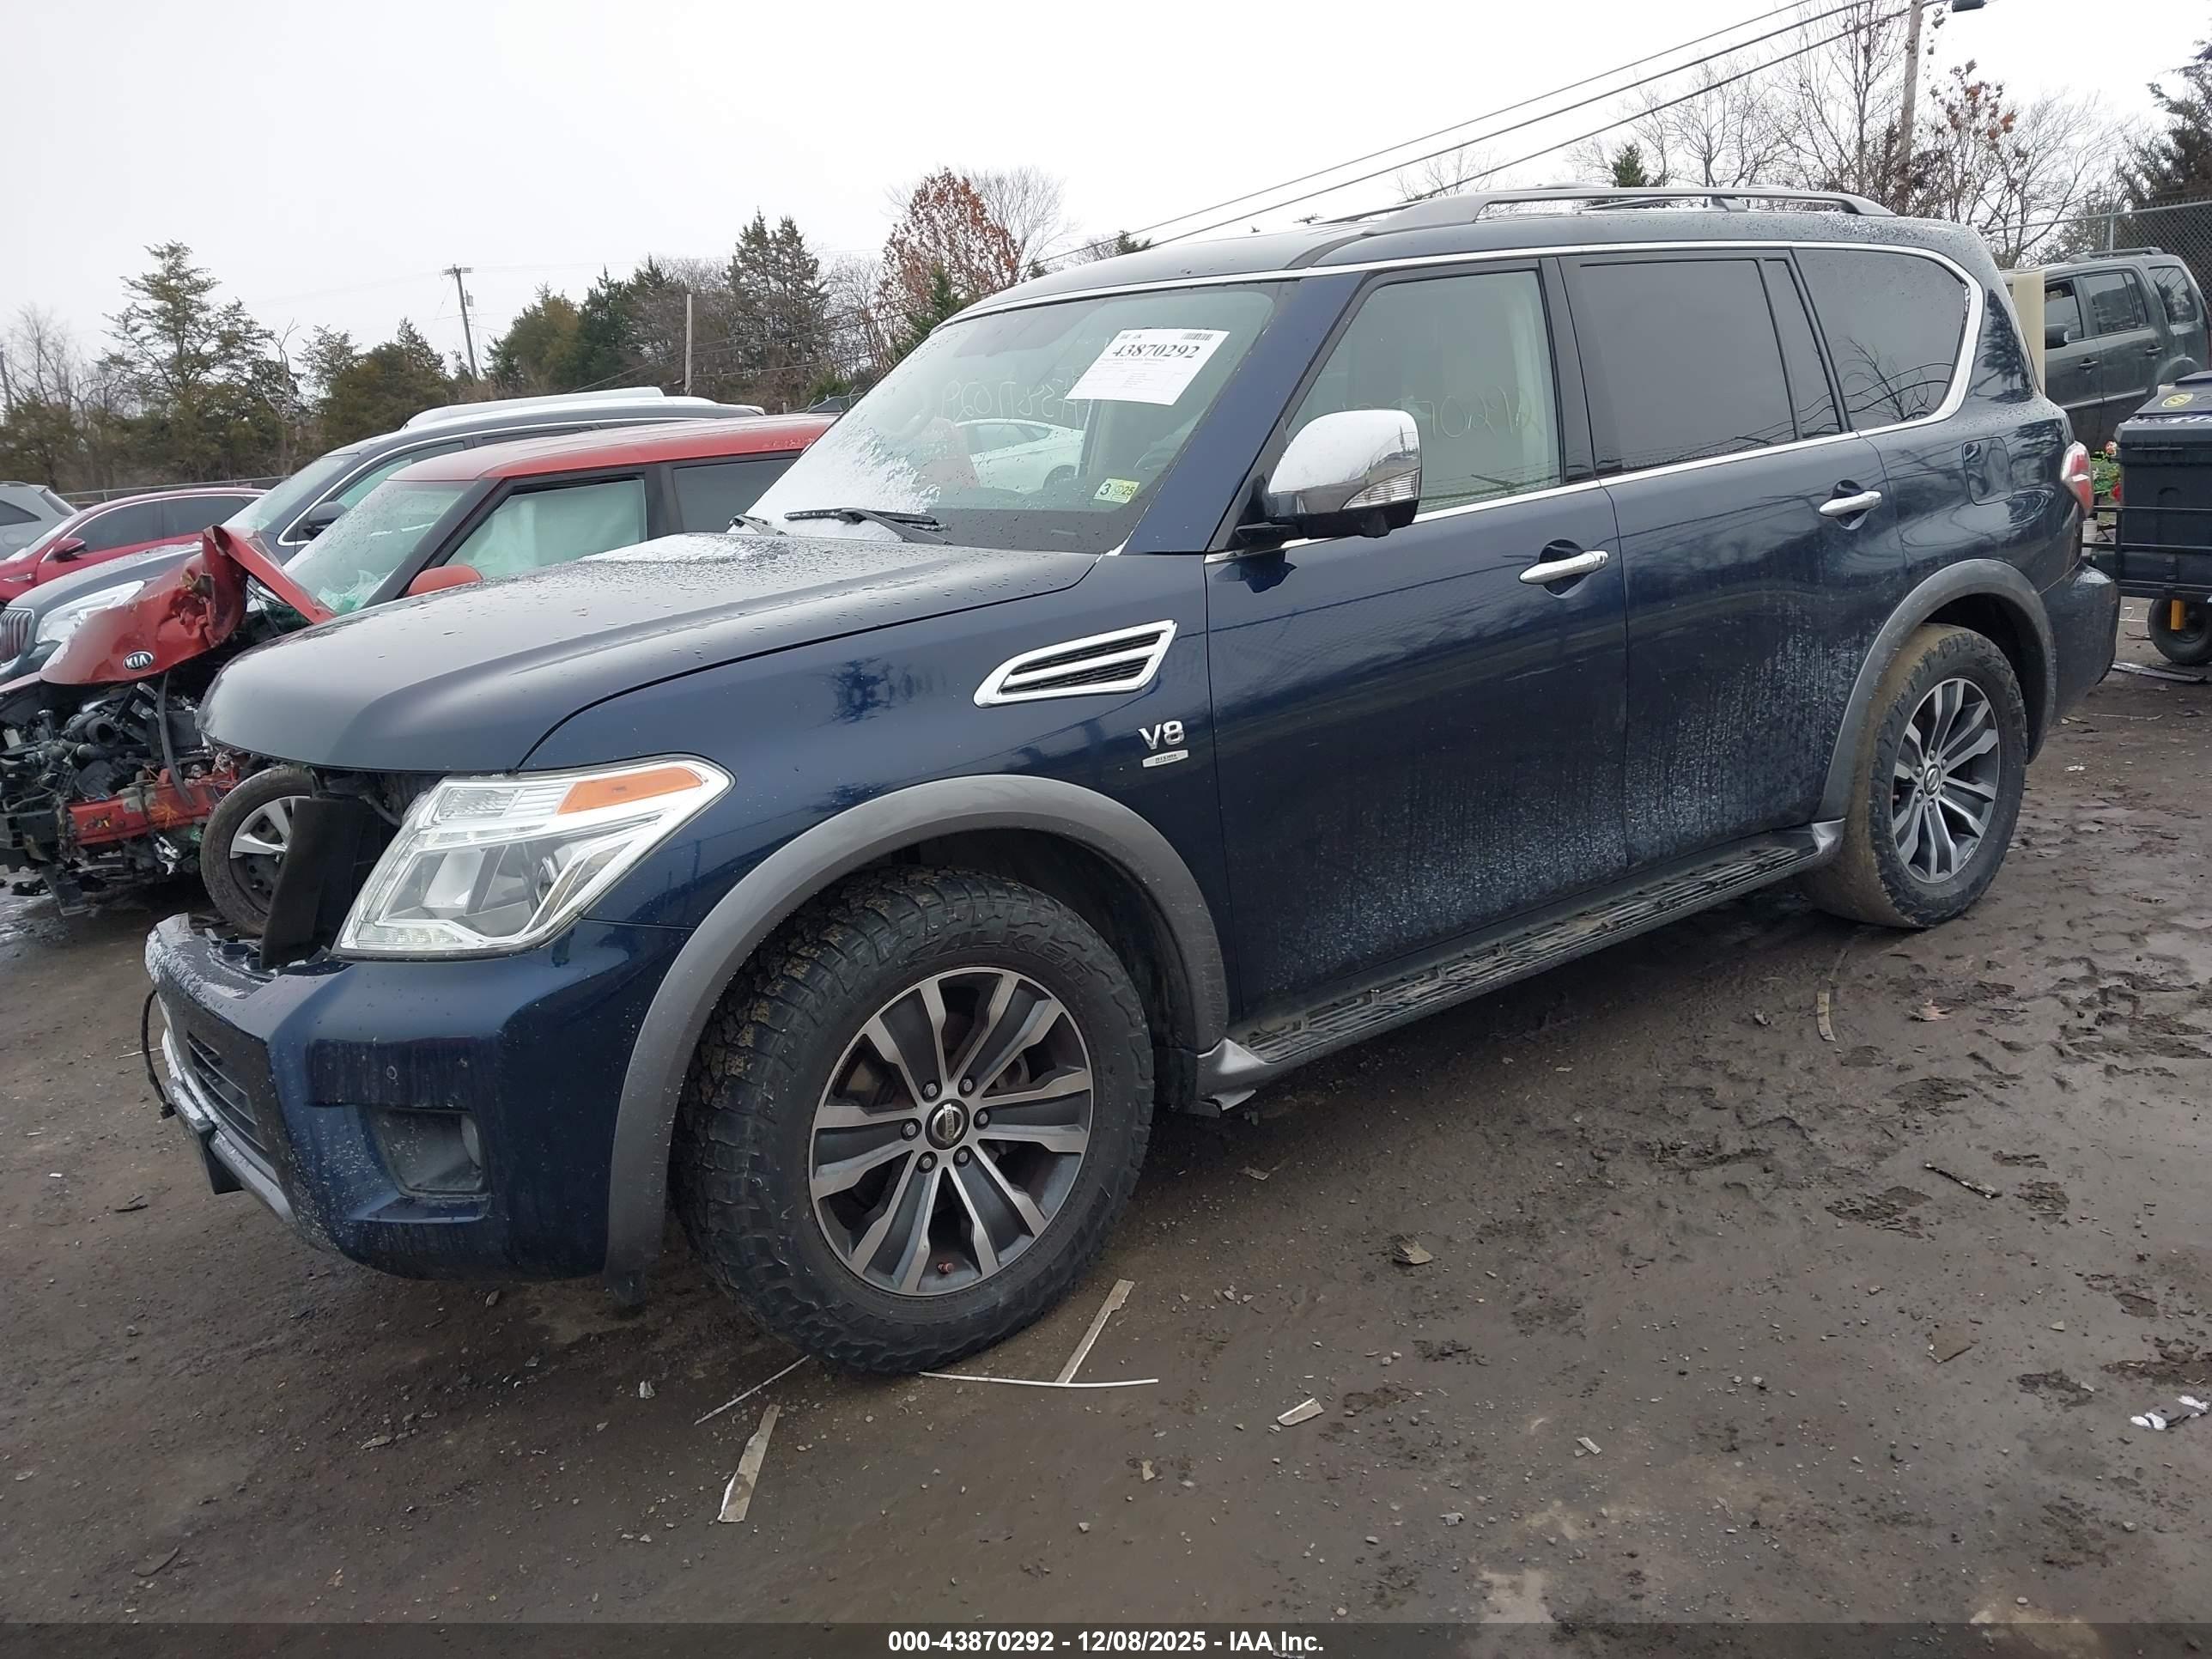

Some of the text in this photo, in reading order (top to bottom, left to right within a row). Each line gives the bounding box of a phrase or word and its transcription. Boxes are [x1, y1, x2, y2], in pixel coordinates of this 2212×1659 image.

[1112, 343, 1200, 359] 43870292
[1100, 483, 1135, 495] 3 25
[126, 654, 149, 668] KIA
[1138, 720, 1185, 750] V8
